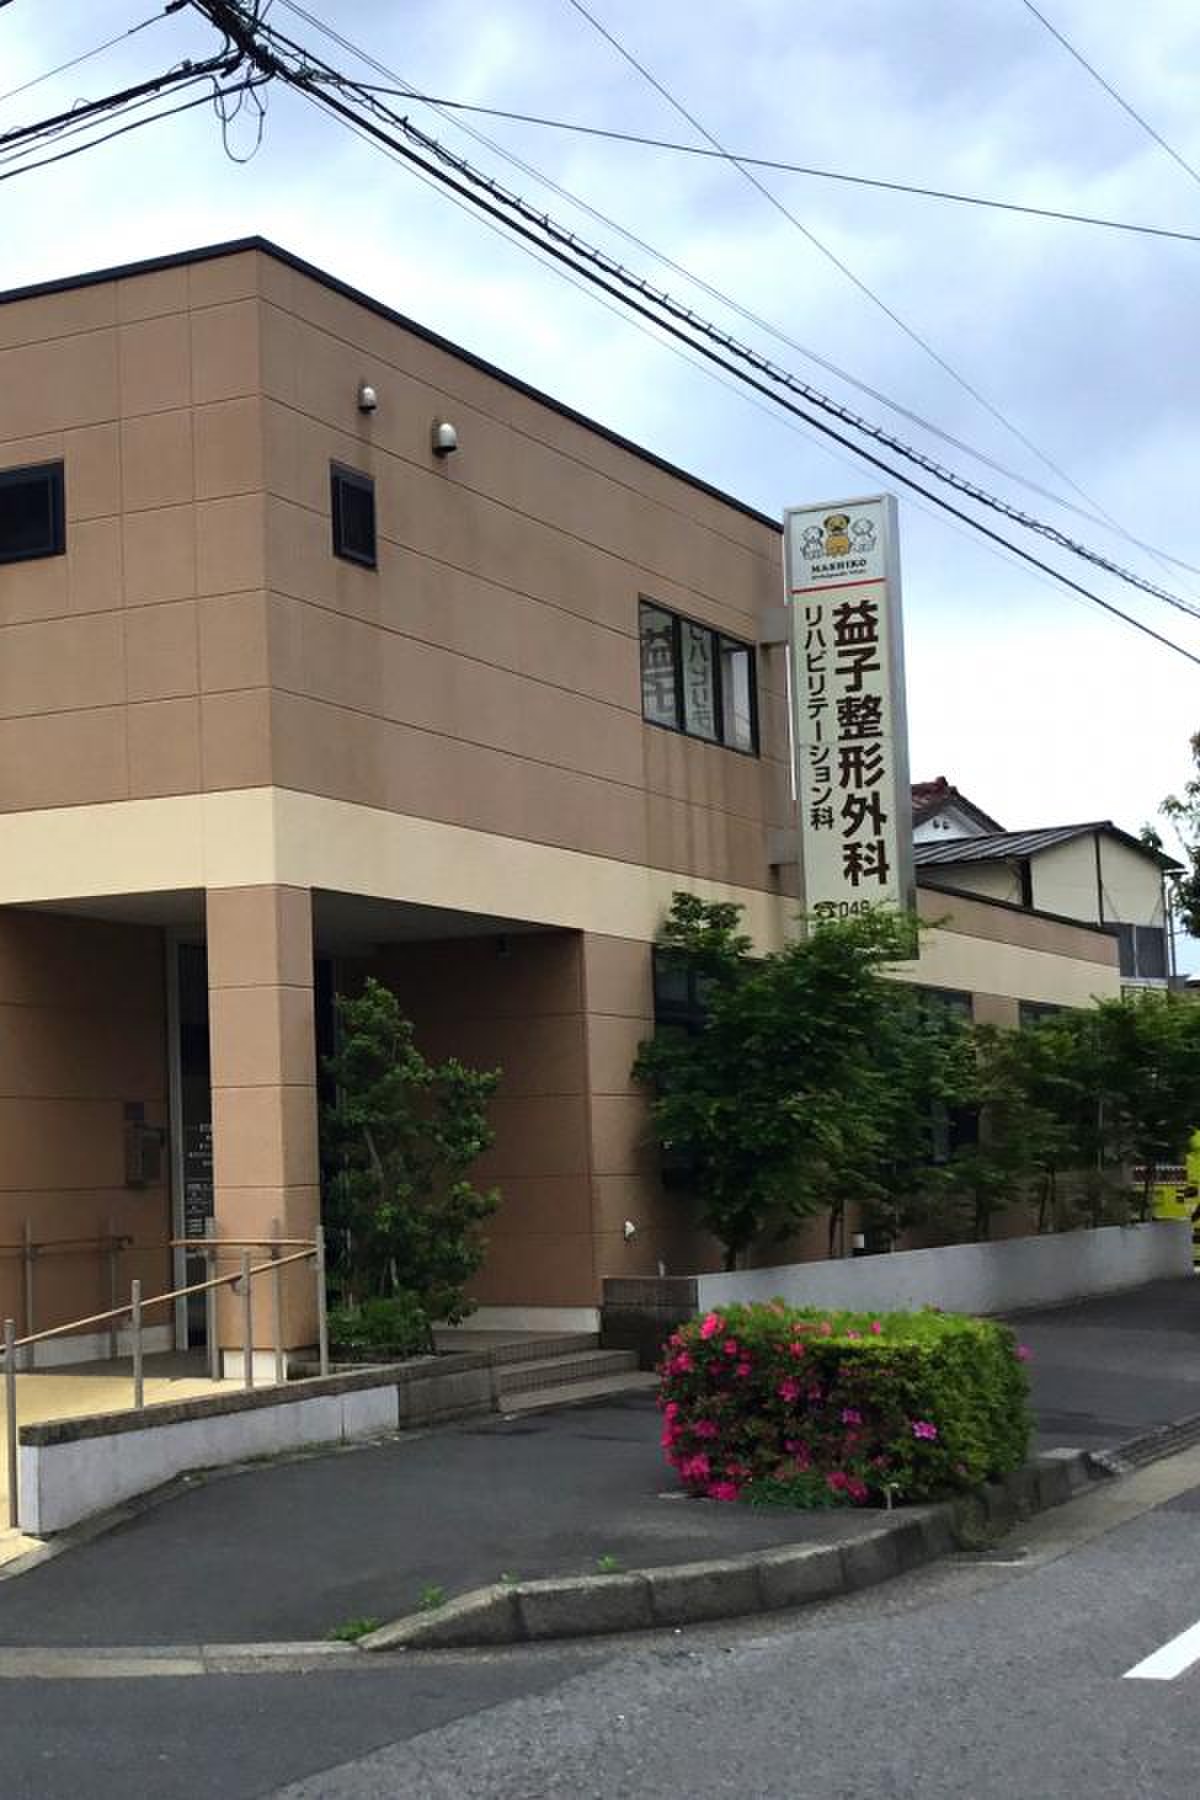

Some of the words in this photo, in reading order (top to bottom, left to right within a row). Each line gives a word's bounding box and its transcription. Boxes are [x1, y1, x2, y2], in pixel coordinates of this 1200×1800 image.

[805, 605, 834, 830] リハビリテーション科
[832, 600, 890, 886] 益子整形外科
